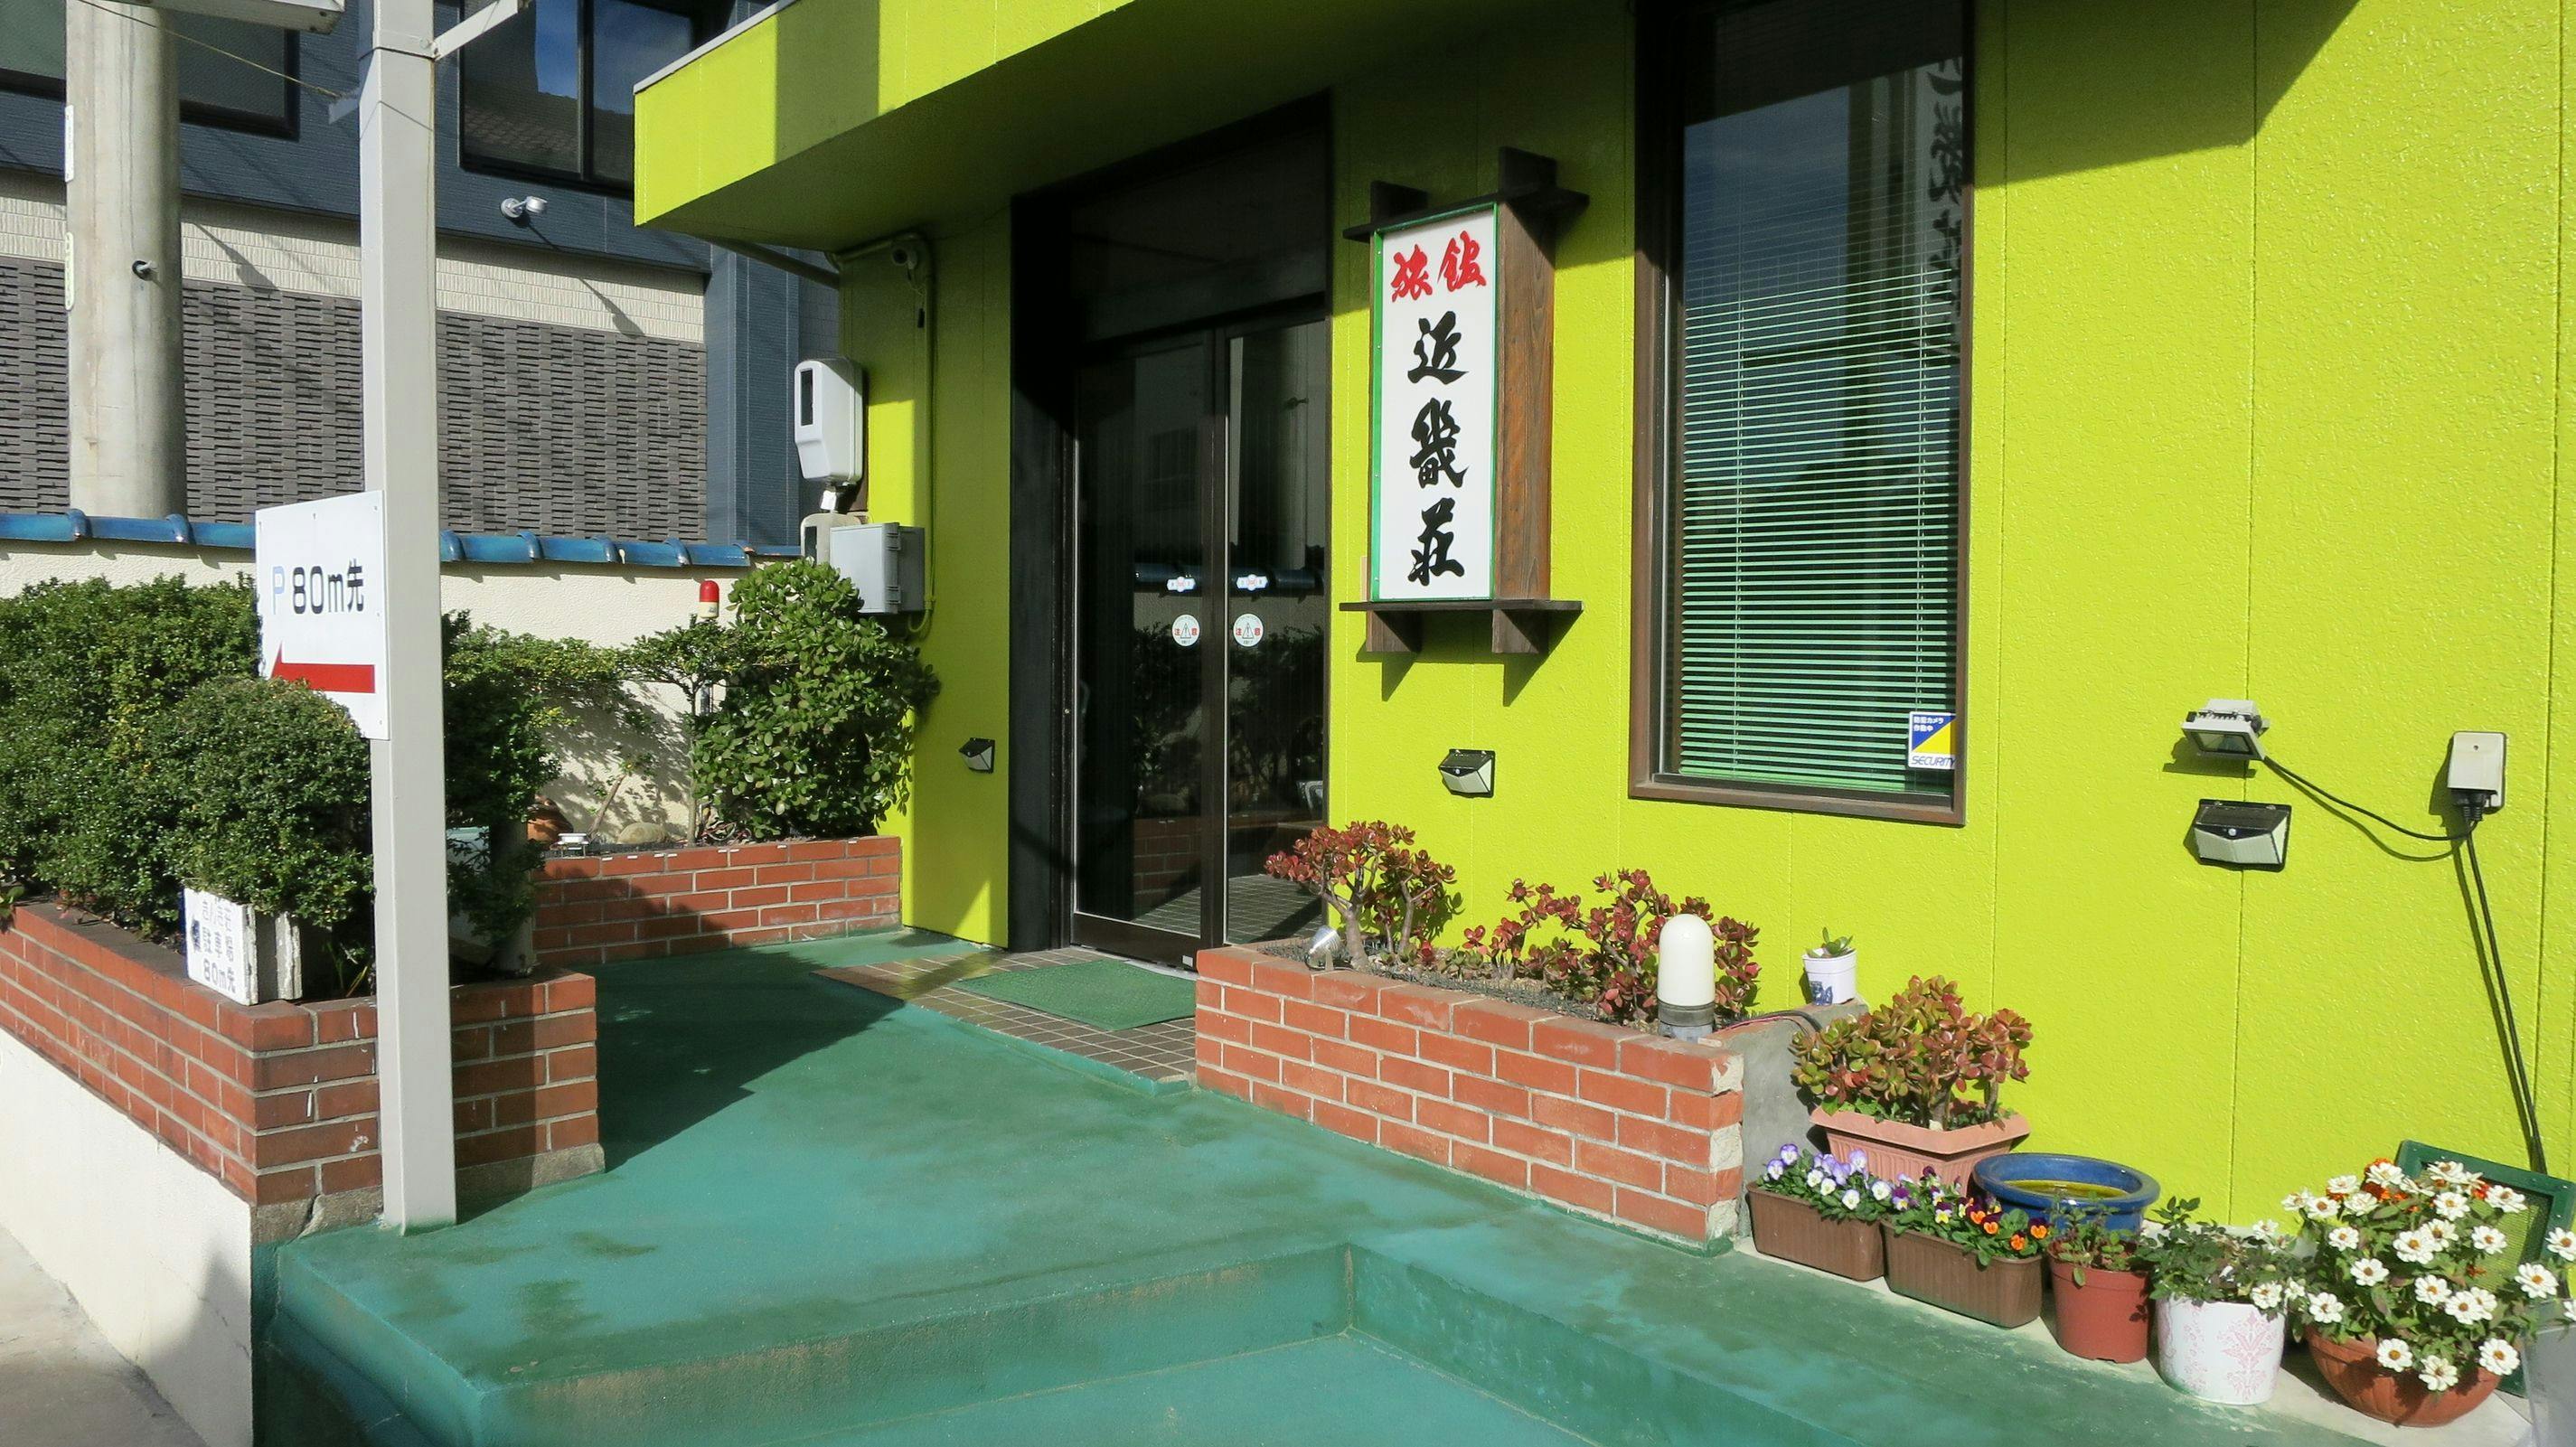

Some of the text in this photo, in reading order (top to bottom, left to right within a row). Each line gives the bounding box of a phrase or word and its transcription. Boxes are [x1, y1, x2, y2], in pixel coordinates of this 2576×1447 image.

[1407, 310, 1470, 587] 近畿荘
[272, 557, 364, 615] P 80m先
[1911, 755, 1956, 767] SECURITY
[203, 958, 236, 993] 80m先
